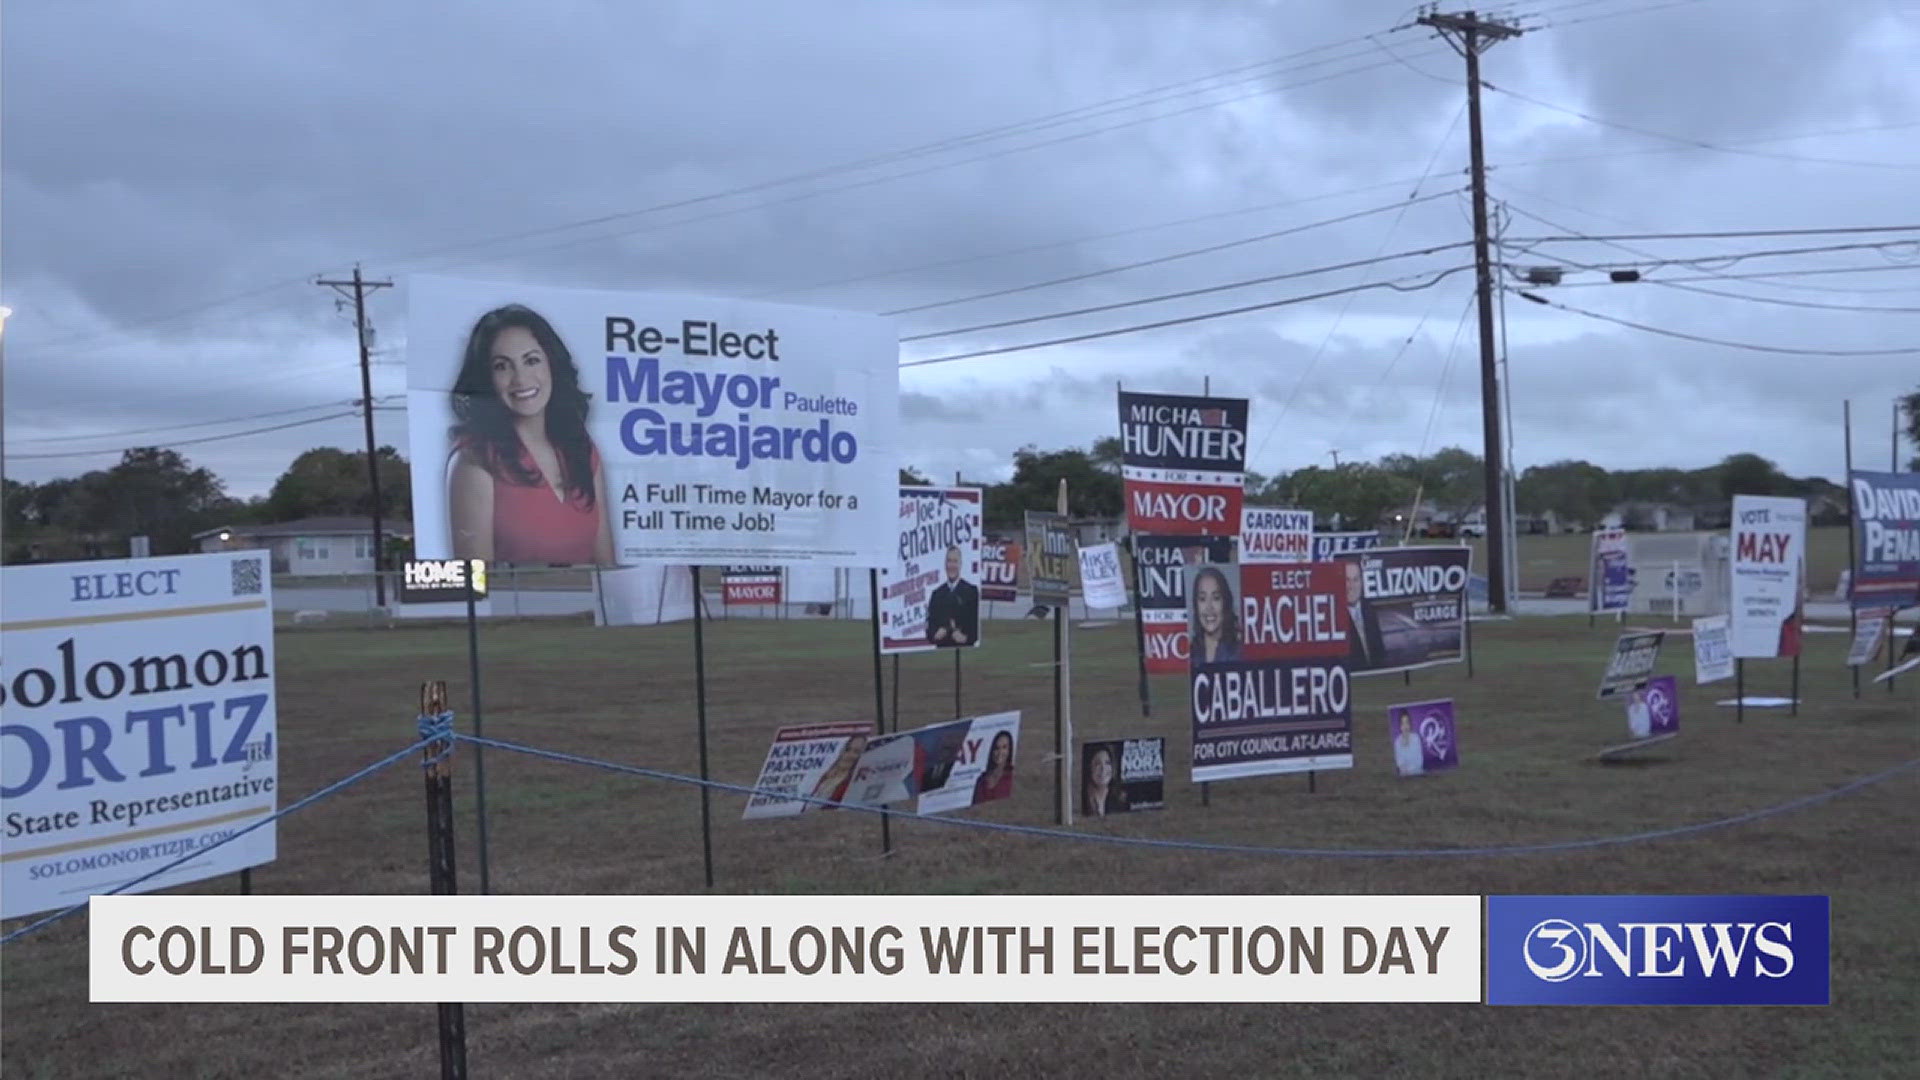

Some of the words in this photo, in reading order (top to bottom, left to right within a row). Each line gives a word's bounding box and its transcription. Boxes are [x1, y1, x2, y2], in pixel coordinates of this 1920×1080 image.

[606, 316, 779, 361] Re-Elect
[606, 356, 780, 417] Mayor
[785, 392, 857, 416] Paulette
[1131, 404, 1232, 427] MICHAL
[620, 408, 857, 470] Guajardo
[1122, 423, 1245, 460] HUNTER
[622, 484, 639, 503] A
[647, 484, 686, 503] Full
[693, 485, 746, 506] Time
[752, 487, 813, 511] Mayor
[819, 490, 843, 509] for
[847, 494, 858, 509] a
[1132, 490, 1228, 522] MAYOR
[1853, 478, 1920, 521] DAVID
[623, 511, 663, 530] Full
[671, 511, 725, 530] Time
[731, 513, 775, 532] Job!
[1246, 512, 1309, 530] CAROLYN
[1740, 509, 1771, 525] VOTE
[899, 509, 972, 561] enavides
[1242, 532, 1309, 552] VAUGHN
[1736, 532, 1790, 563] MAY
[71, 569, 181, 601] ELECT
[404, 559, 465, 584] HOME
[1271, 571, 1312, 589] ELECT
[1363, 565, 1466, 599] ELIZONDO
[728, 586, 775, 599] MAYOR
[1244, 594, 1346, 644] RACHEL
[1194, 665, 1349, 723] CABALLERO
[772, 741, 838, 758] KAYLYNN
[1194, 742, 1215, 760] FOR
[1217, 738, 1240, 757] CITY
[1241, 735, 1289, 755] COUNCIL
[1292, 732, 1350, 751] AT-LARGE
[764, 757, 825, 774] PAXSON
[6, 811, 80, 839] State
[89, 774, 274, 827] Representative
[29, 829, 236, 881] SOLOMONORTIZJR.COM
